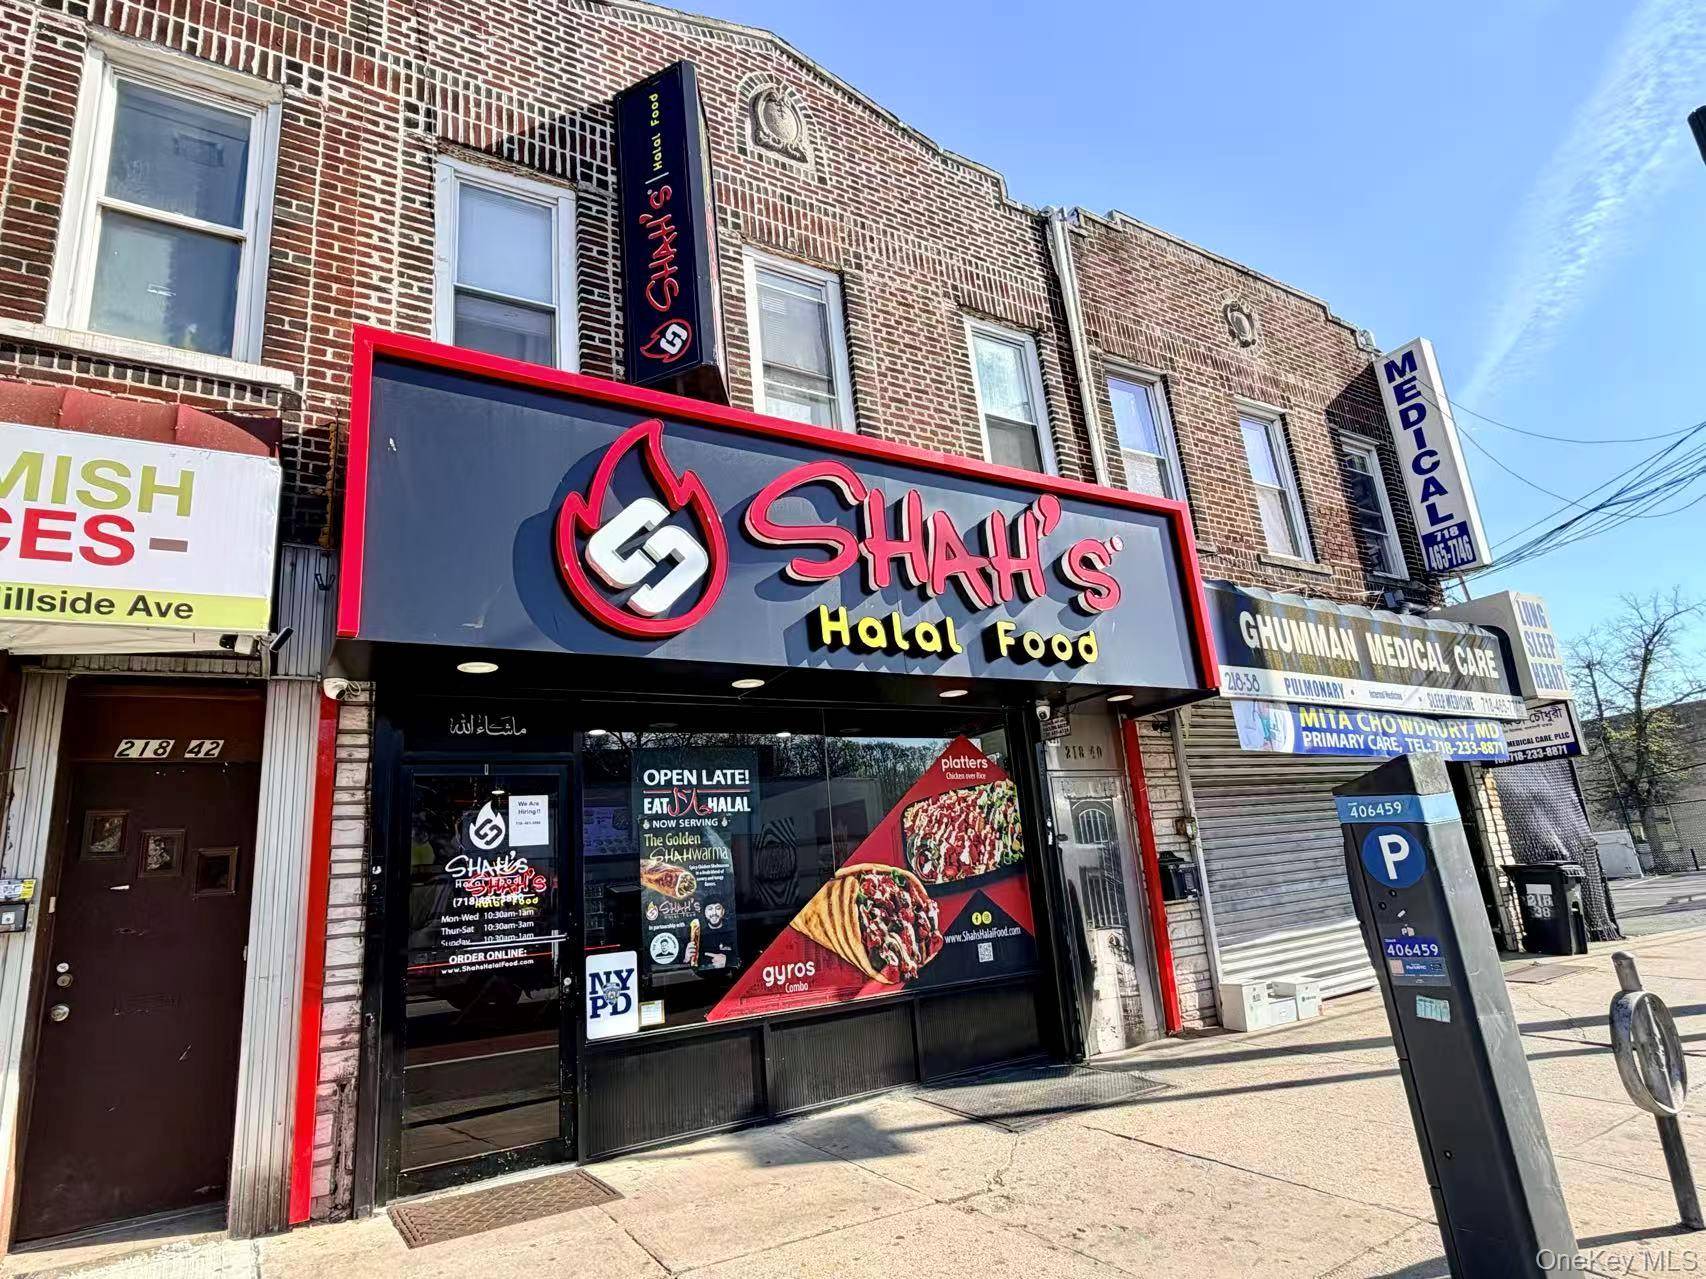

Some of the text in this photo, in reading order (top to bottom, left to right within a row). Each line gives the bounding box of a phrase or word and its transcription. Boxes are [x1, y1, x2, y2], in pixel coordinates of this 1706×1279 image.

[650, 93, 658, 126] Food
[652, 133, 663, 171] Halal
[1384, 350, 1454, 527] MEDICAL
[1434, 526, 1459, 542] 718
[1429, 535, 1474, 571] 465-7746
[0, 586, 194, 620] illside Ave
[1517, 600, 1548, 629] LUNG
[819, 603, 1099, 664] Halal Food
[1239, 612, 1500, 680] GHUMMAN MEDICAL CARE
[1524, 630, 1557, 659] SLEEP
[1531, 662, 1568, 691] HEART
[1224, 671, 1261, 693] 218-38
[1283, 677, 1346, 700] PULMONARY
[1426, 692, 1446, 709] SLEEP
[1445, 693, 1476, 712] MEDICINE
[1299, 706, 1354, 730] MITA
[1474, 721, 1501, 739] MD
[1302, 731, 1506, 756] PRIMARY CARE, TEL: 718-233-8871
[1553, 731, 1571, 742] PLLC
[116, 740, 221, 757] 218 42
[1508, 744, 1569, 762] 718-233-8871
[941, 754, 989, 771] platters
[643, 769, 750, 786] OPEN LATE!
[946, 772, 965, 780] Chicken
[976, 771, 987, 780] Rice
[643, 796, 751, 814] EAT HALAL
[1350, 802, 1402, 818] 406459
[652, 818, 719, 829] NOW SERVING
[644, 832, 701, 847] The Golden
[1378, 833, 1410, 880] P
[441, 908, 535, 924] Mon-Wed 10:30am-1am
[441, 920, 535, 936] Thur-Sat 10:30am-3am
[944, 926, 1022, 944] www.ShahsHalalFood.com
[449, 947, 527, 965] ORDER ONLINE:
[1387, 943, 1439, 956] 406459
[762, 959, 816, 987] gyros
[785, 980, 809, 994] Combo
